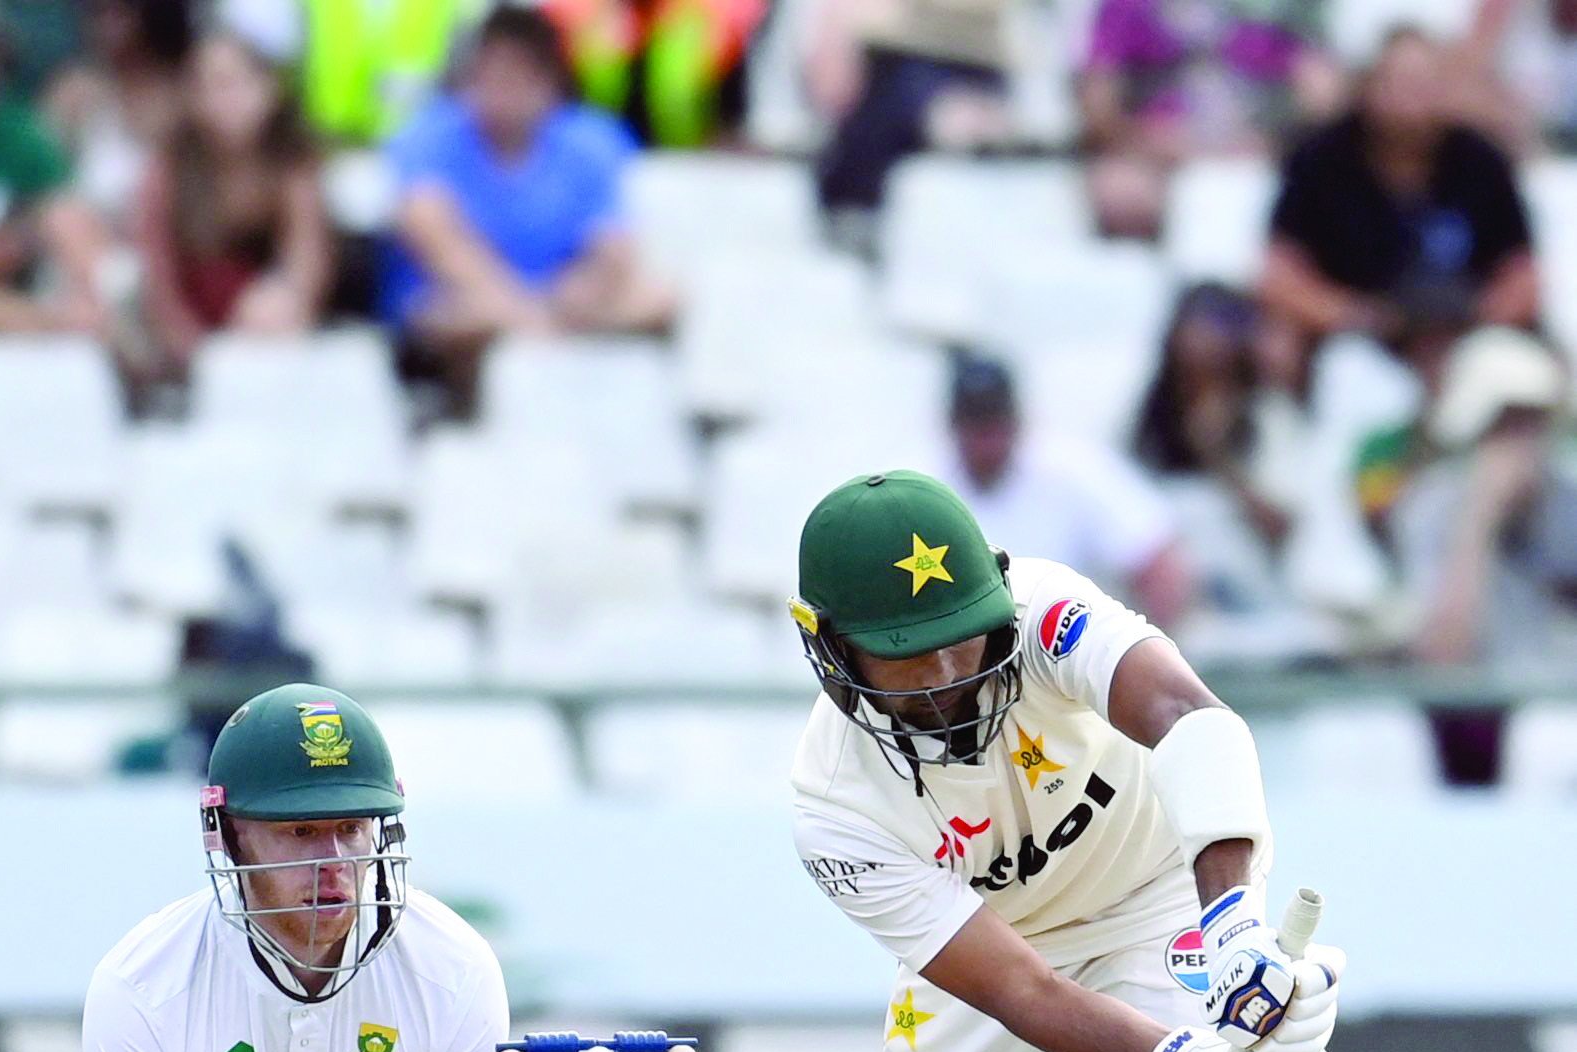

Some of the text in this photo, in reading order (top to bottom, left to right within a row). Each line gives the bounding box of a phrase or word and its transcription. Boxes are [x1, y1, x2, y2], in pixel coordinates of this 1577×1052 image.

[1043, 778, 1065, 794] 255
[1205, 962, 1244, 1013] MALIK
[1239, 996, 1272, 1030] MB
